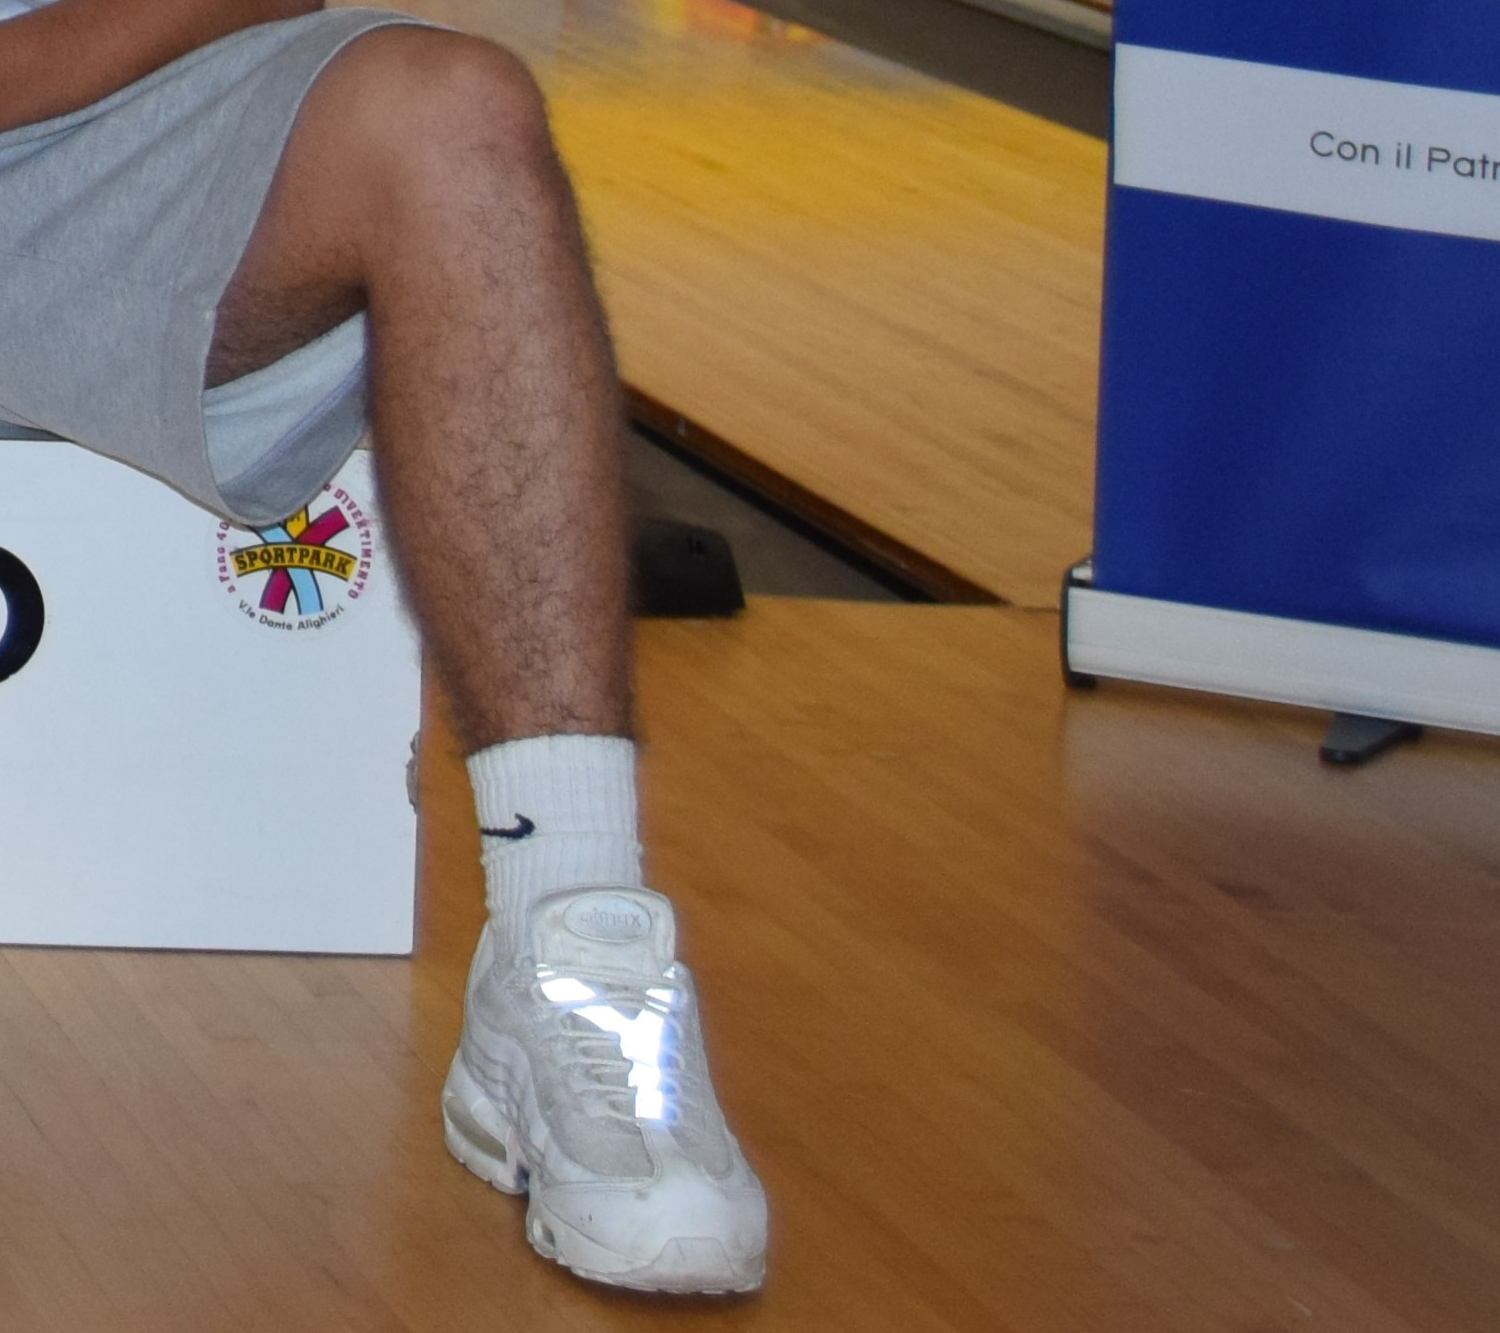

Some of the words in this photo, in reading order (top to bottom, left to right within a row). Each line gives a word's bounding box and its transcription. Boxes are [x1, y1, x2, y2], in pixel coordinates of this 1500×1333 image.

[1309, 130, 1381, 166] Con
[1395, 141, 1412, 170] il
[234, 546, 353, 576] SPORTPARK
[237, 598, 257, 620] V.le
[258, 613, 294, 632] Dante
[296, 603, 346, 632] Alighieri
